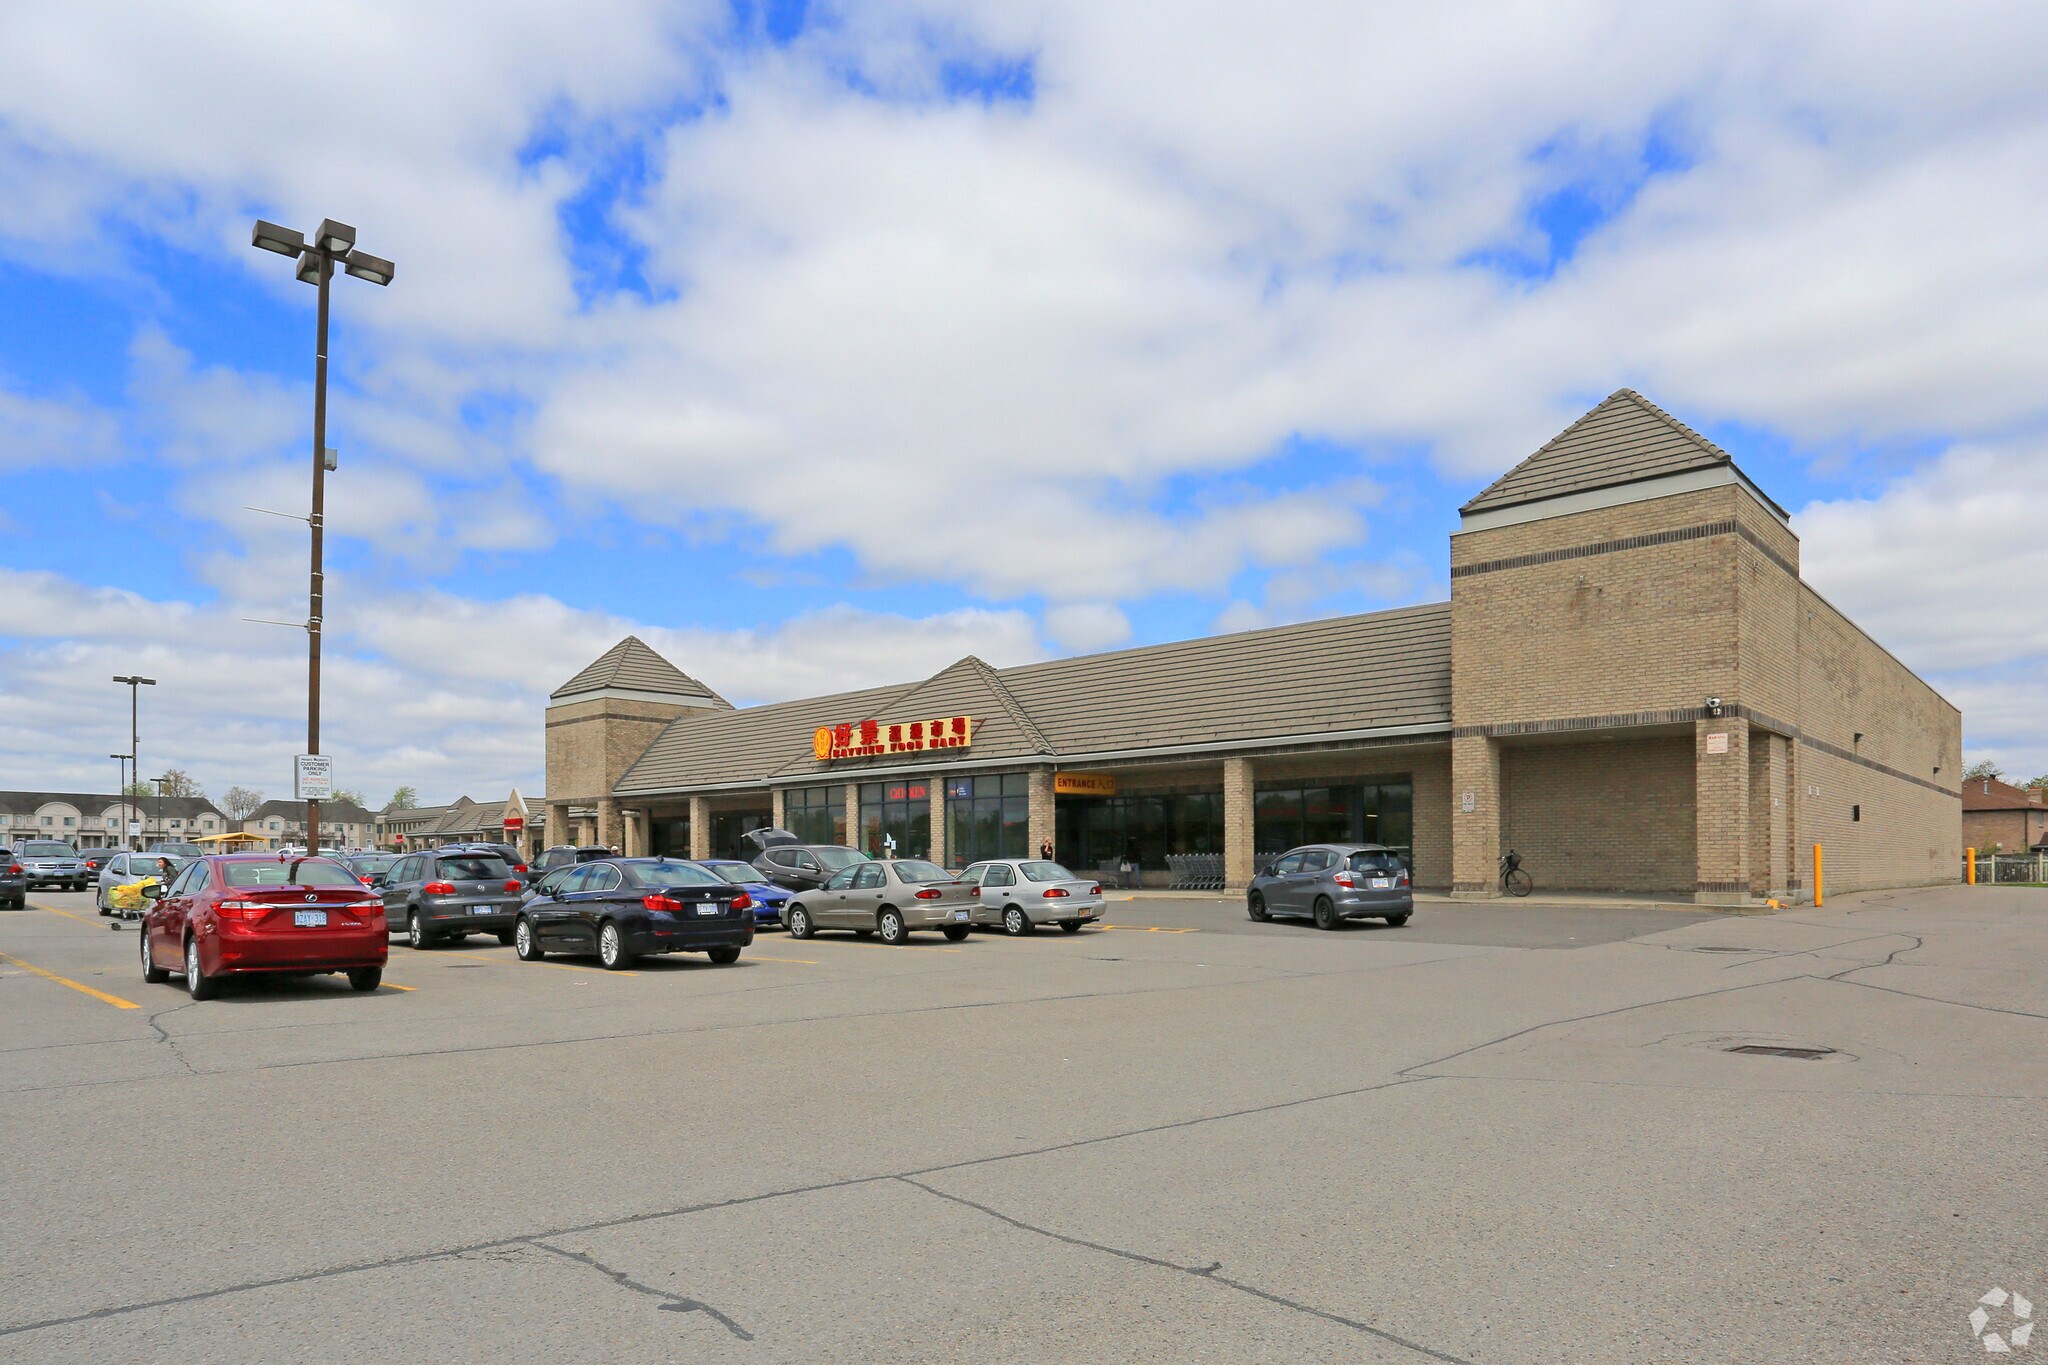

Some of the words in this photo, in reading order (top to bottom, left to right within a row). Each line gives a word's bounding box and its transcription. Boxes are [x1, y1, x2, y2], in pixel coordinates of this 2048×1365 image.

[890, 740, 923, 752] FOOD
[929, 736, 966, 748] MART
[1057, 778, 1096, 789] ENTRANCE
